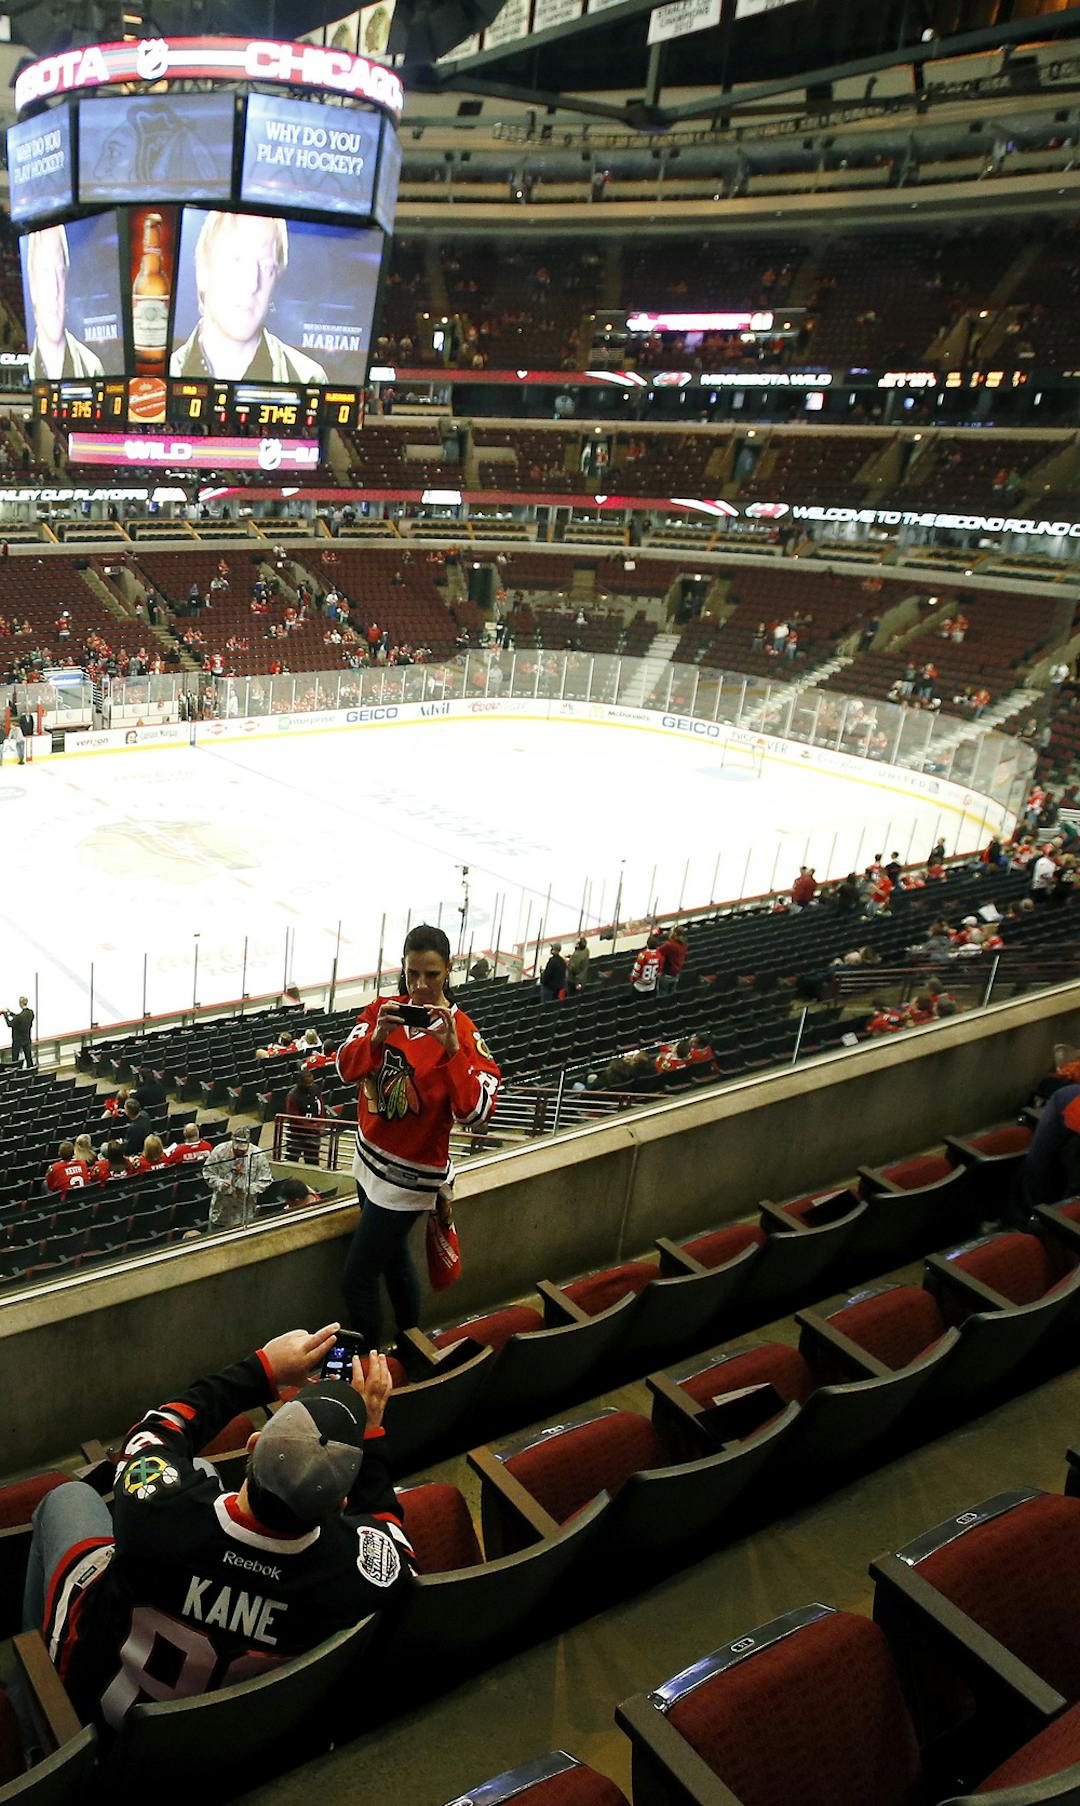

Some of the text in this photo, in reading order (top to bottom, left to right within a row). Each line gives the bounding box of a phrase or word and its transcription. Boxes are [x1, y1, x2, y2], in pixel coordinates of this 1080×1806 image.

[266, 120, 361, 153] WHY DO YOU
[257, 143, 364, 176] PLAY HOCKEY?
[302, 332, 360, 351] MARIAN
[700, 372, 833, 387] MINNESOTA WILD
[124, 440, 194, 461] WILD
[41, 488, 73, 502] CUP
[74, 488, 150, 502] PLAYOFFS
[792, 506, 876, 524] WELCOME
[876, 511, 903, 525] TO
[903, 512, 934, 527] THE
[934, 514, 1004, 532] SECOND
[1003, 518, 1070, 536] ROUND
[346, 706, 398, 724] GEICO
[661, 715, 721, 738] GEICO
[222, 1550, 283, 1581] Reebok
[181, 1575, 289, 1647] KANE
